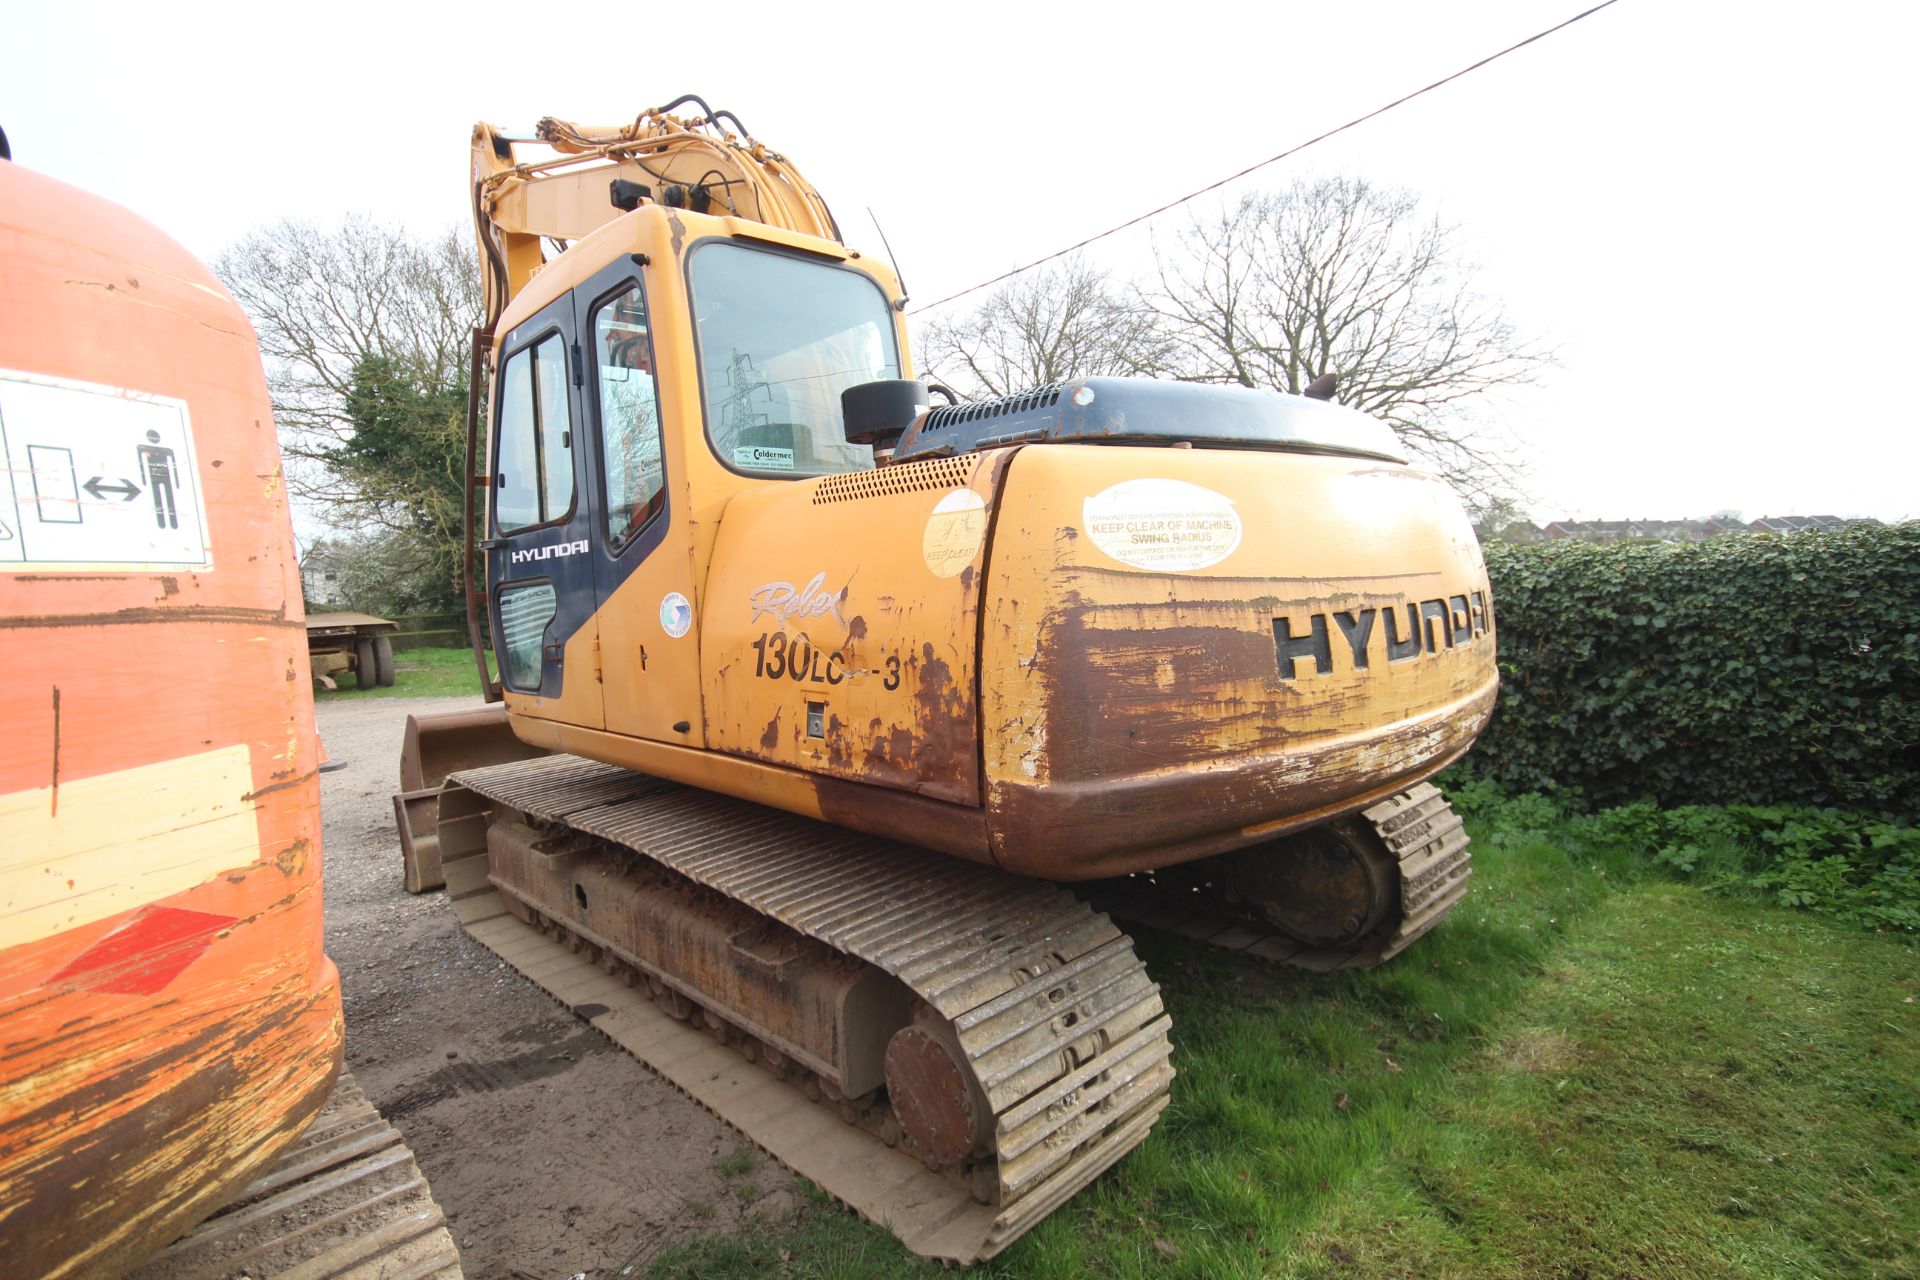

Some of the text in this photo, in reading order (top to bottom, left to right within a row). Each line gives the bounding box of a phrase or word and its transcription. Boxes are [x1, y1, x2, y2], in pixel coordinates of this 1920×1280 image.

[753, 448, 792, 460] Caldermec
[1092, 519, 1232, 534] KEEP CLEAR OF MACHINE
[1131, 532, 1212, 544] SWING RADIUS
[511, 539, 589, 564] HYUNDAI
[926, 547, 975, 560] KEEP CLEAR
[1272, 590, 1490, 682] HYUNDAI
[752, 631, 845, 685] 130LC
